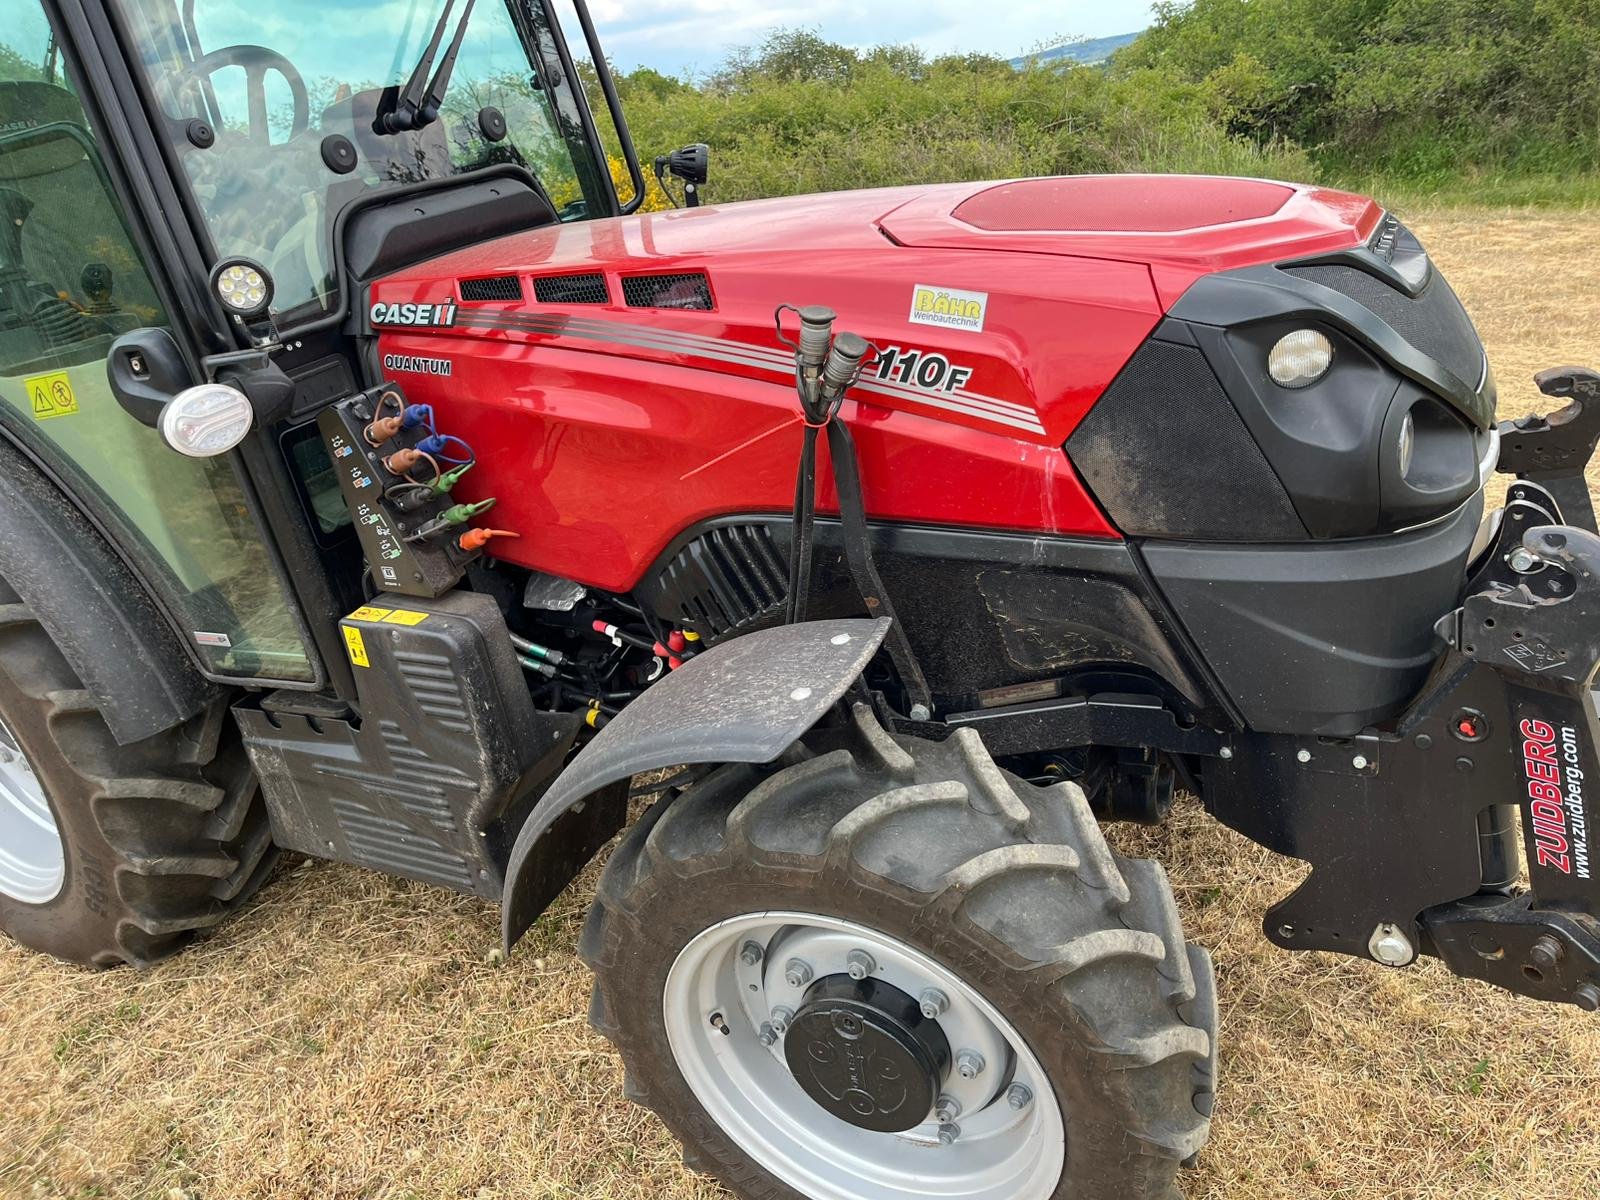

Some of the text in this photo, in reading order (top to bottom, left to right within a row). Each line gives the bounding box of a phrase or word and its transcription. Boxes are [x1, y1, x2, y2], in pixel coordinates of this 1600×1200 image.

[370, 302, 433, 325] CASE
[915, 288, 982, 320] BÄHR
[913, 310, 979, 328] Weinbautechnik
[384, 354, 452, 376] QUANTUM
[1520, 718, 1571, 874] ZUIDBERG
[1560, 727, 1591, 880] www.zuidberg.com
